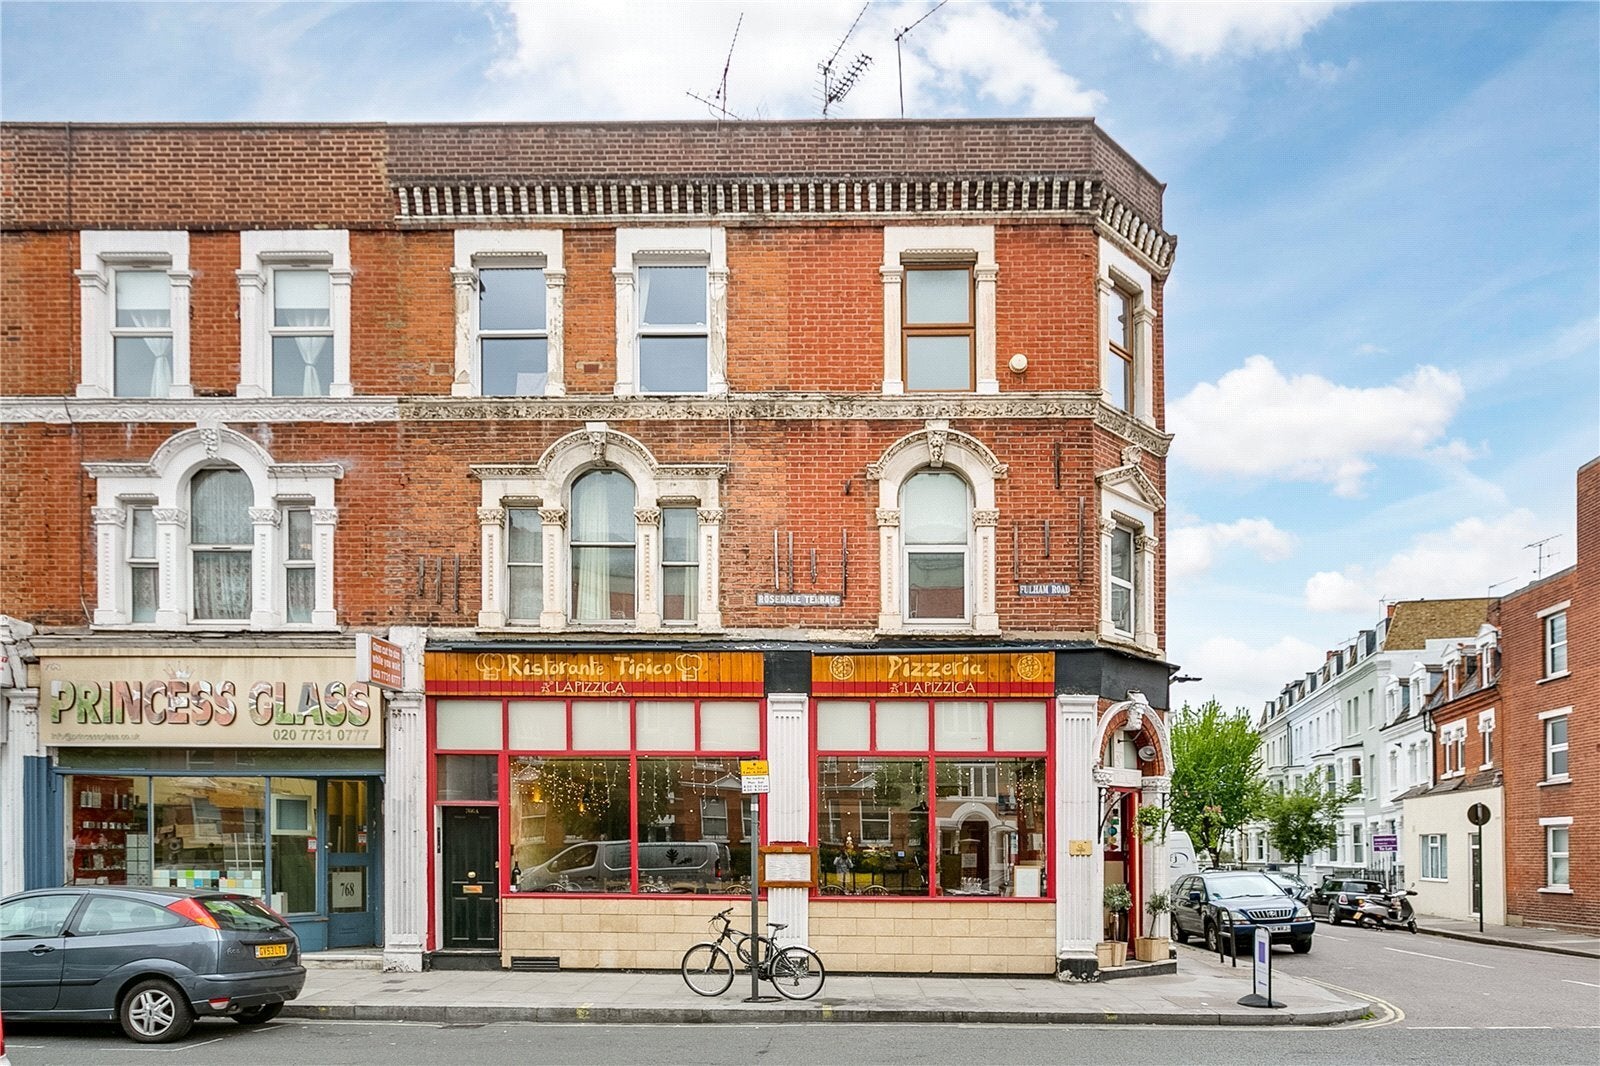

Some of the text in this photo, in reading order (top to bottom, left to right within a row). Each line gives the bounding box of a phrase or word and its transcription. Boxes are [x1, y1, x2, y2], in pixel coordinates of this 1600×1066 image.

[1020, 584, 1071, 595] FULHAM ROAD
[758, 594, 841, 604] ROSEDALE TERRACE
[507, 654, 672, 679] Ristorante Tipico
[887, 655, 985, 679] Pizzeria
[51, 680, 371, 727] PRINCESS GLASS
[273, 729, 369, 741] 020 7731 0777
[340, 882, 355, 897] 768
